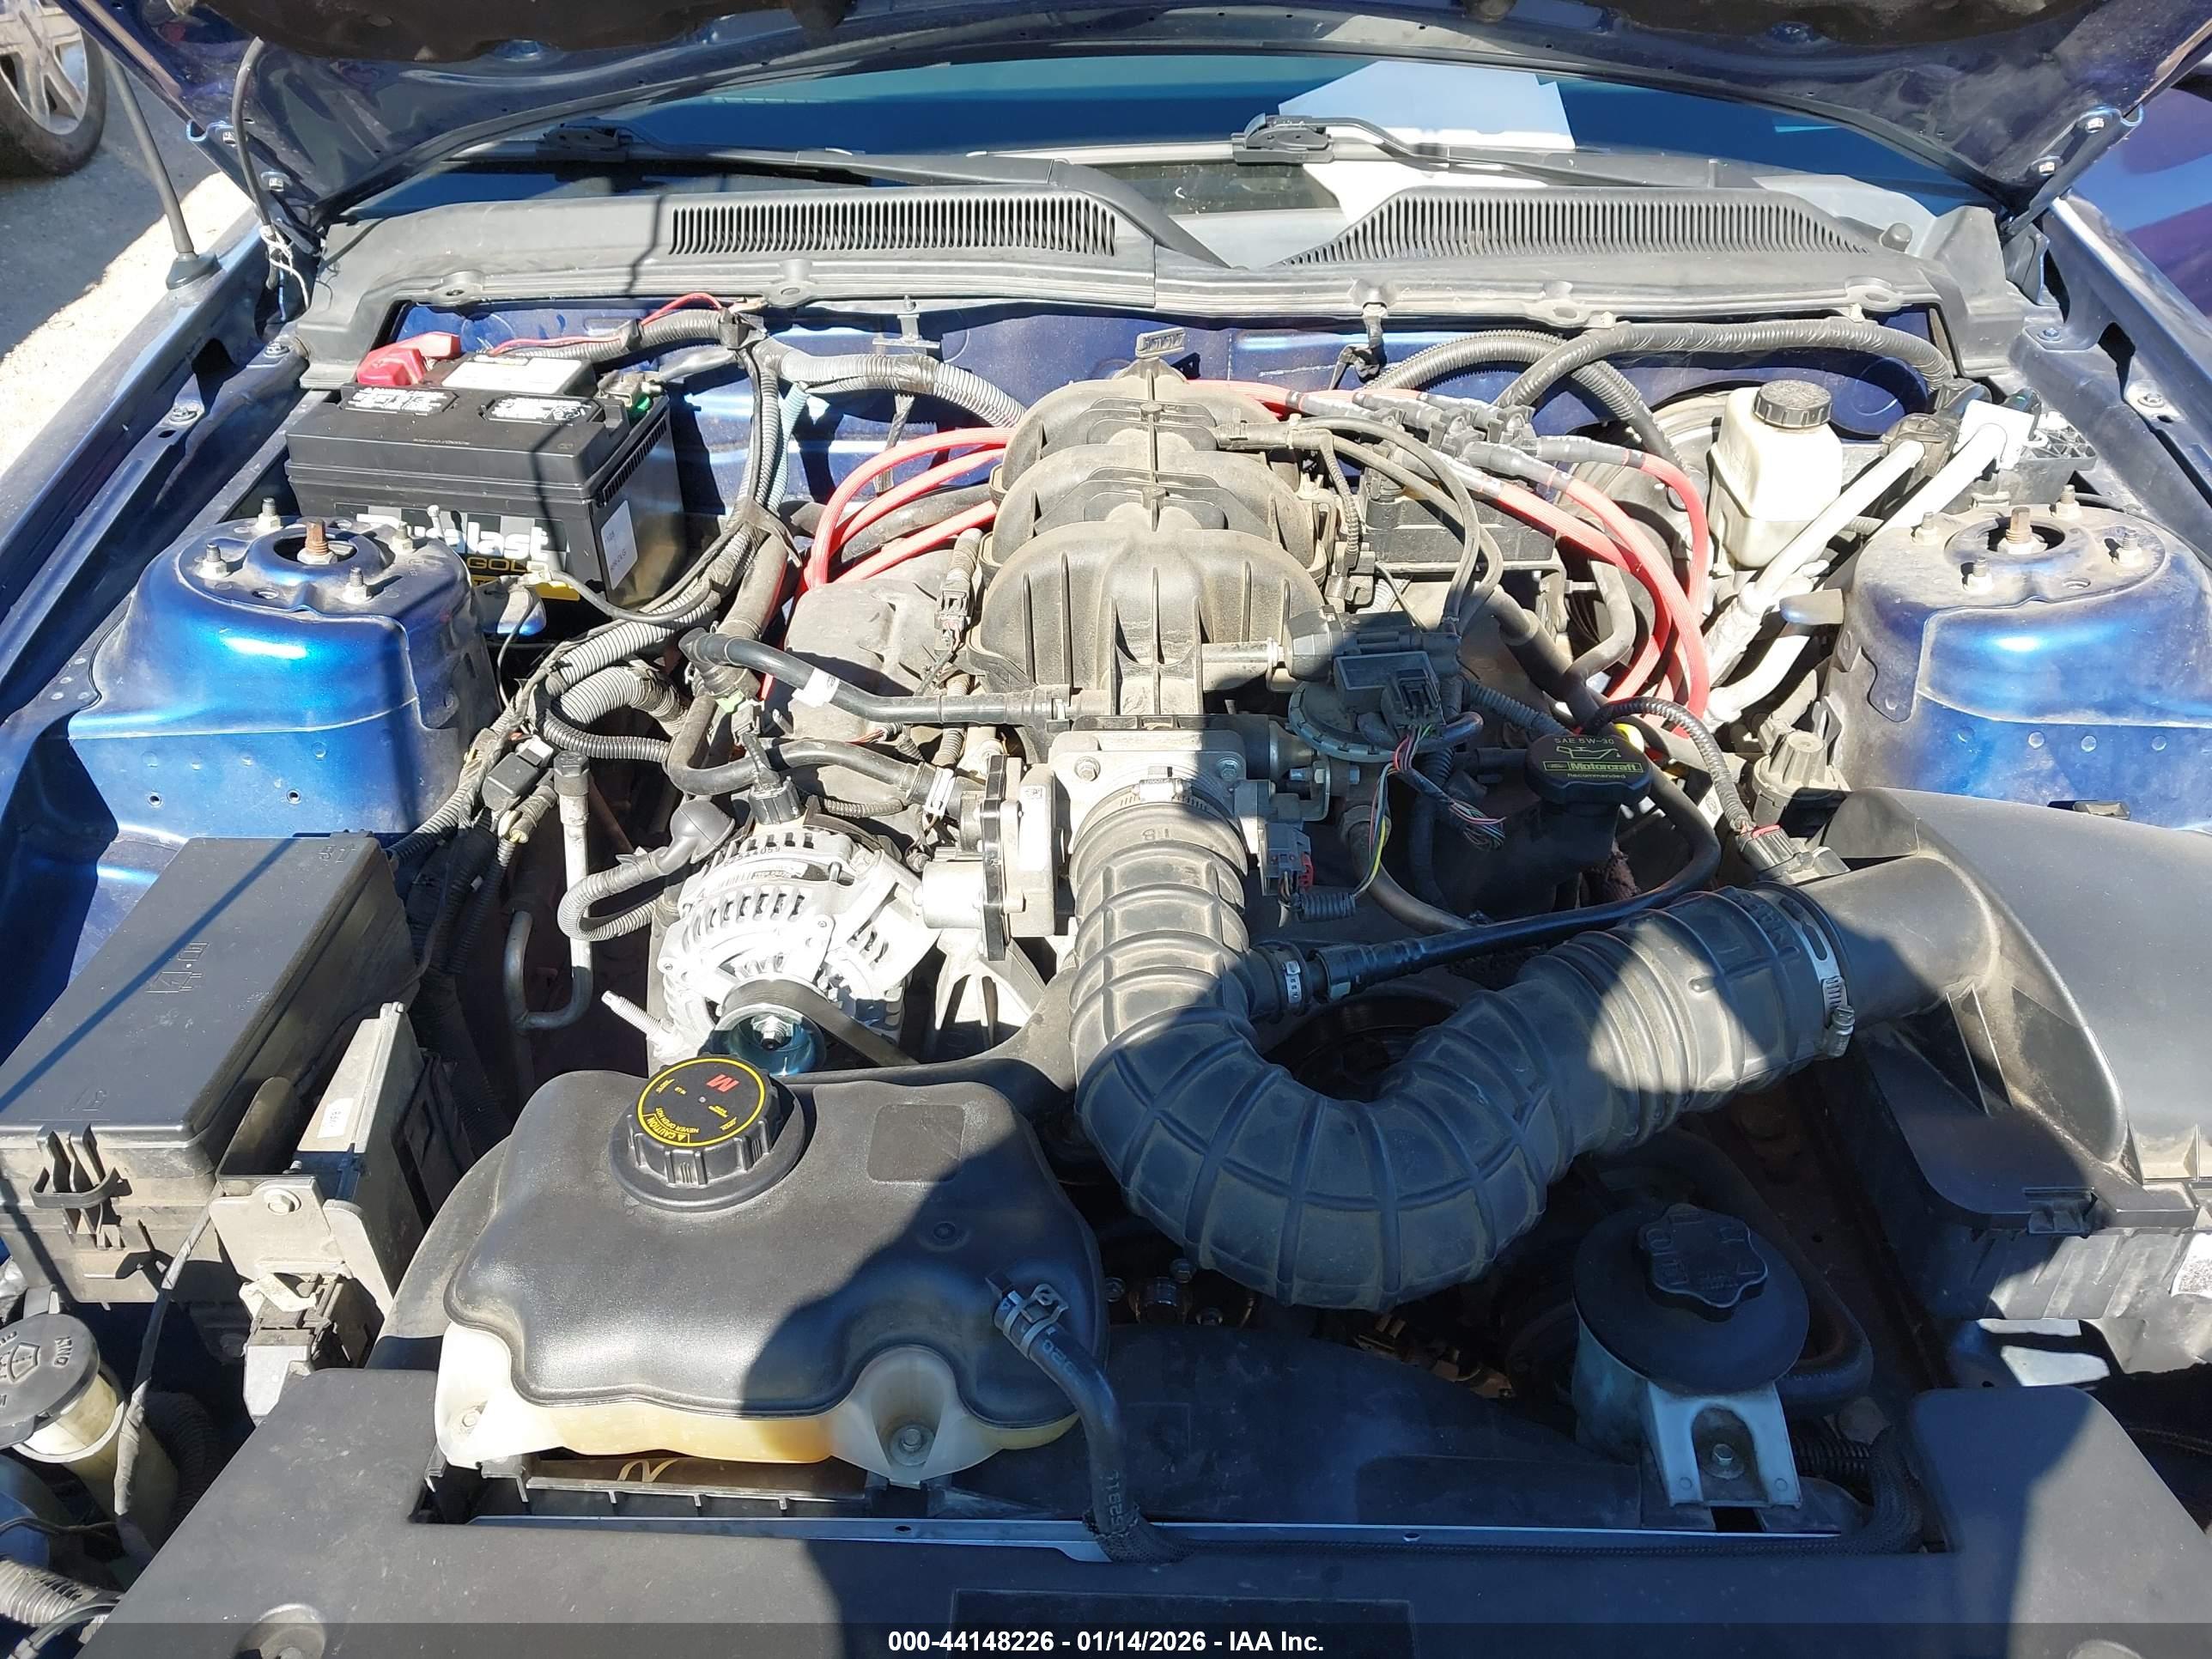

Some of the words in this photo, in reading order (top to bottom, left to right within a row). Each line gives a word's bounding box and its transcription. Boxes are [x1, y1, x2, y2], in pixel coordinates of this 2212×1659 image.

[655, 1107, 665, 1118] HOT
[647, 1117, 677, 1139] CAUTION
[660, 1114, 676, 1129] OPEN
[676, 1125, 700, 1133] NEVER
